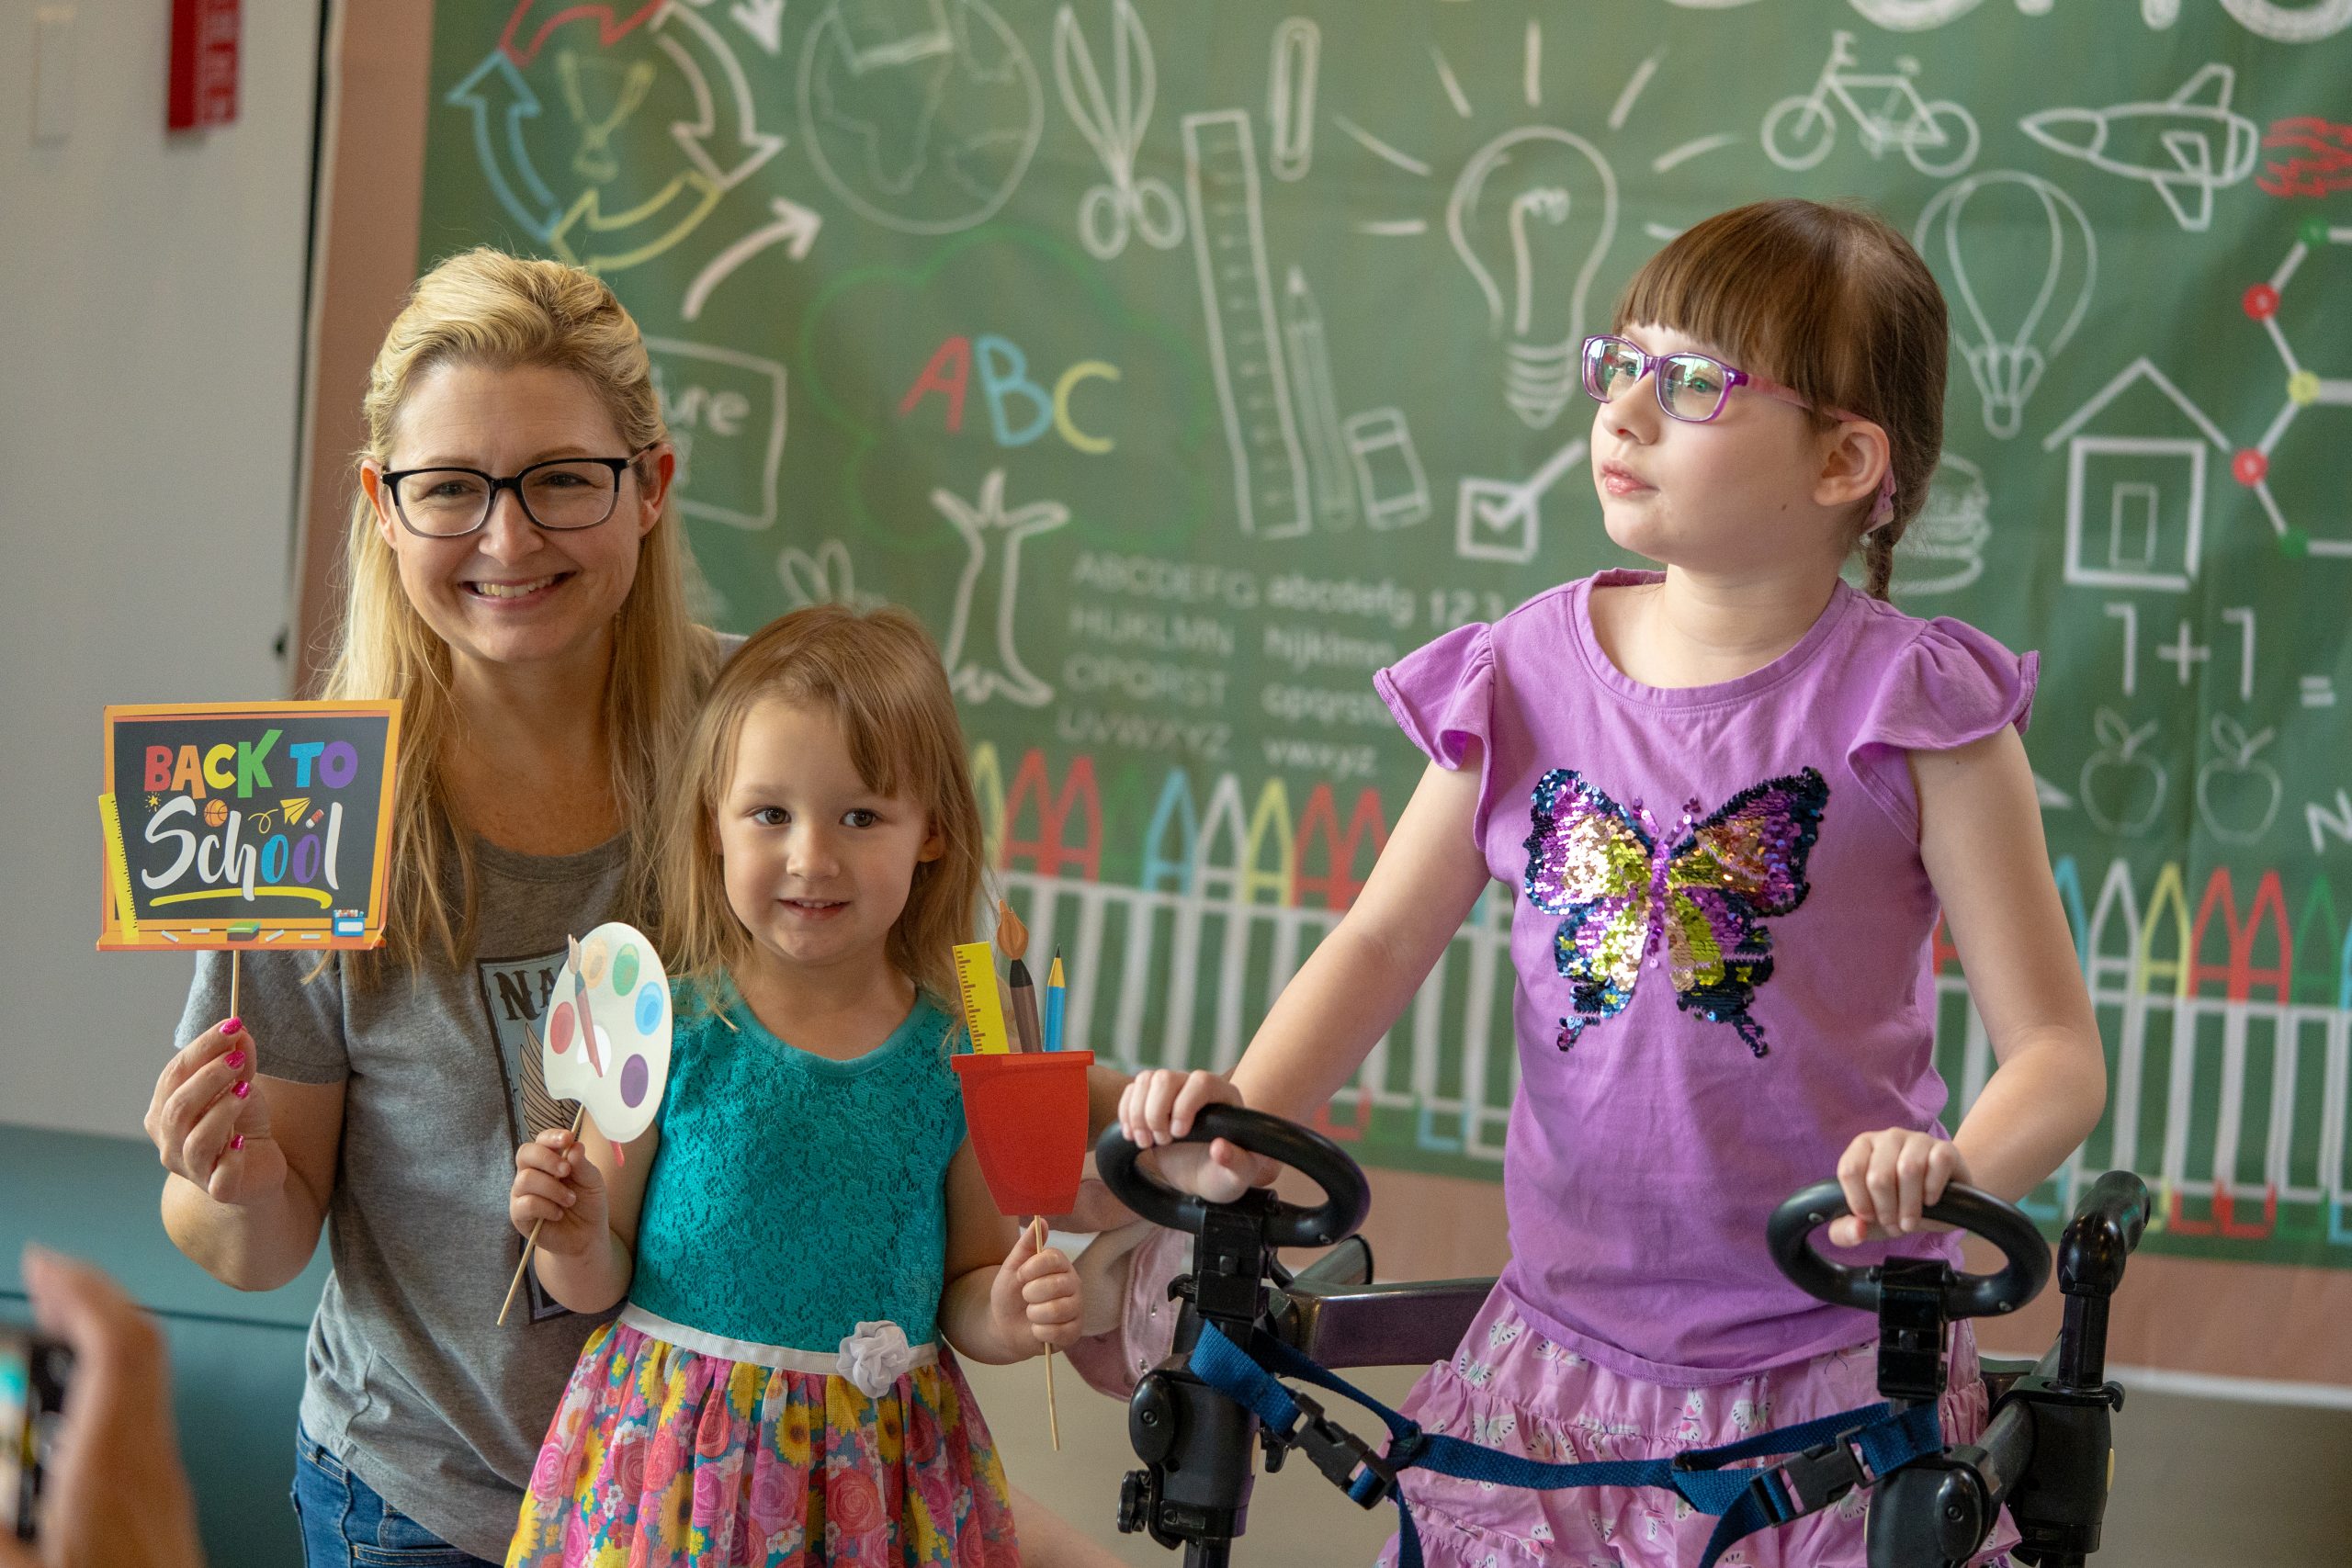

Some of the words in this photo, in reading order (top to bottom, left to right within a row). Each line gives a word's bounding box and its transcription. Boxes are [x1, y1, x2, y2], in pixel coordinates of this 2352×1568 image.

[899, 334, 1122, 454] ABC
[144, 729, 283, 799] BACK
[289, 740, 358, 789] TO
[141, 795, 344, 901] School
[492, 964, 564, 1021] NA
